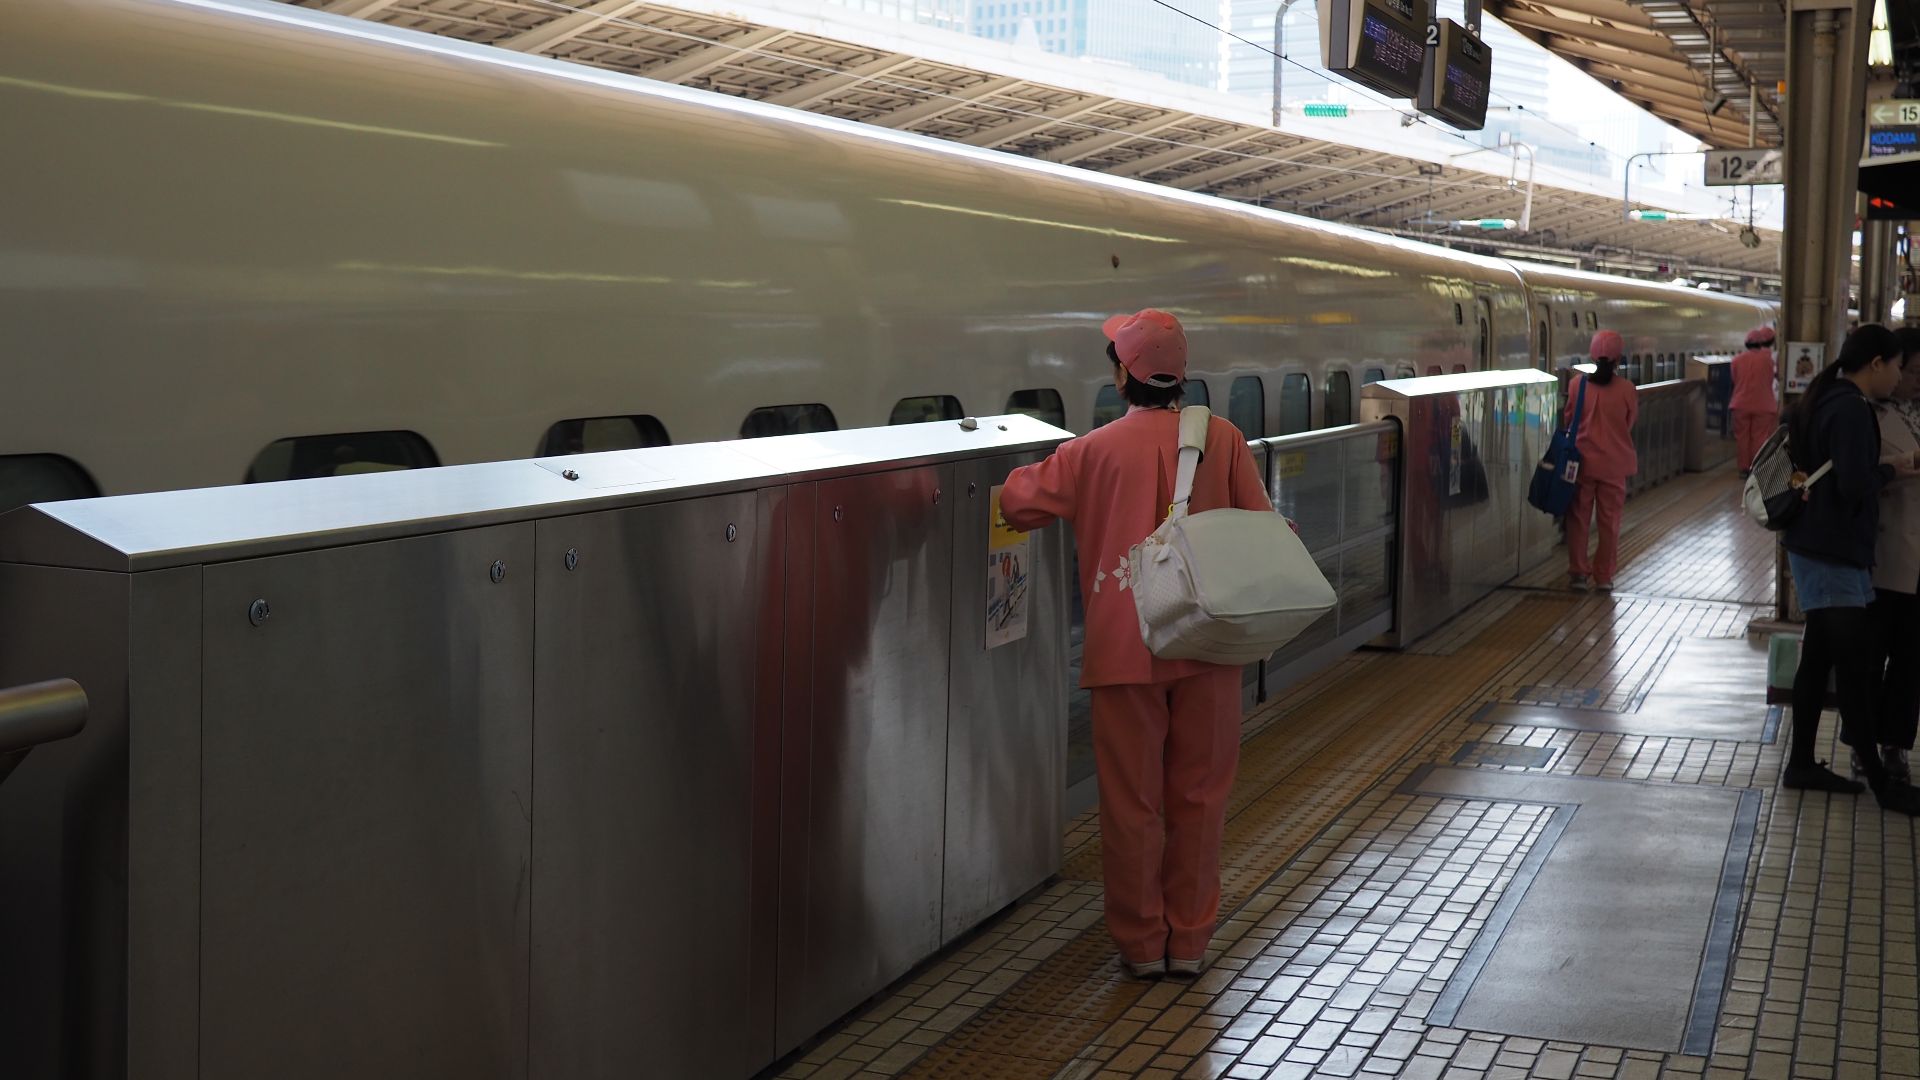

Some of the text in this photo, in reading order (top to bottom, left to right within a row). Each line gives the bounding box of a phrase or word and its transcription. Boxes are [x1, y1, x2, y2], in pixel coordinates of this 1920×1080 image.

[1426, 24, 1438, 45] 2
[1902, 106, 1918, 121] 15
[1871, 131, 1917, 145] KODAMA
[1721, 156, 1742, 179] 12
